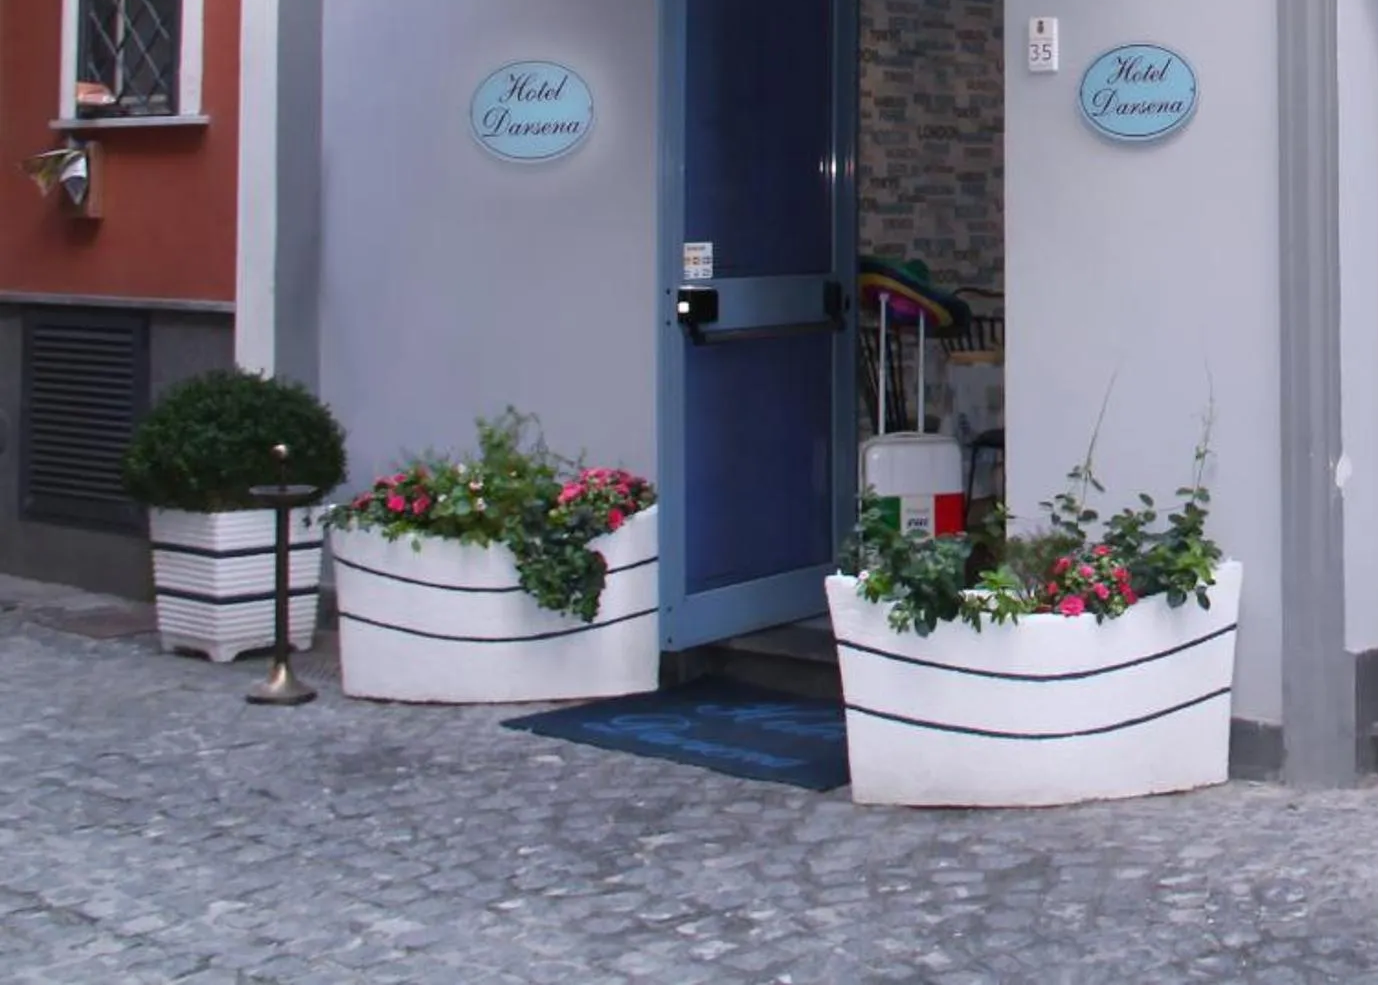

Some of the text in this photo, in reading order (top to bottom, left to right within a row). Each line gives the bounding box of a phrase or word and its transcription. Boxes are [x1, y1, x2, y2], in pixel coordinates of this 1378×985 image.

[1029, 43, 1052, 62] 35
[1106, 56, 1173, 84] Hotel
[498, 73, 569, 103] Hotel
[1091, 88, 1184, 117] Darsena
[481, 105, 581, 137] Darsena
